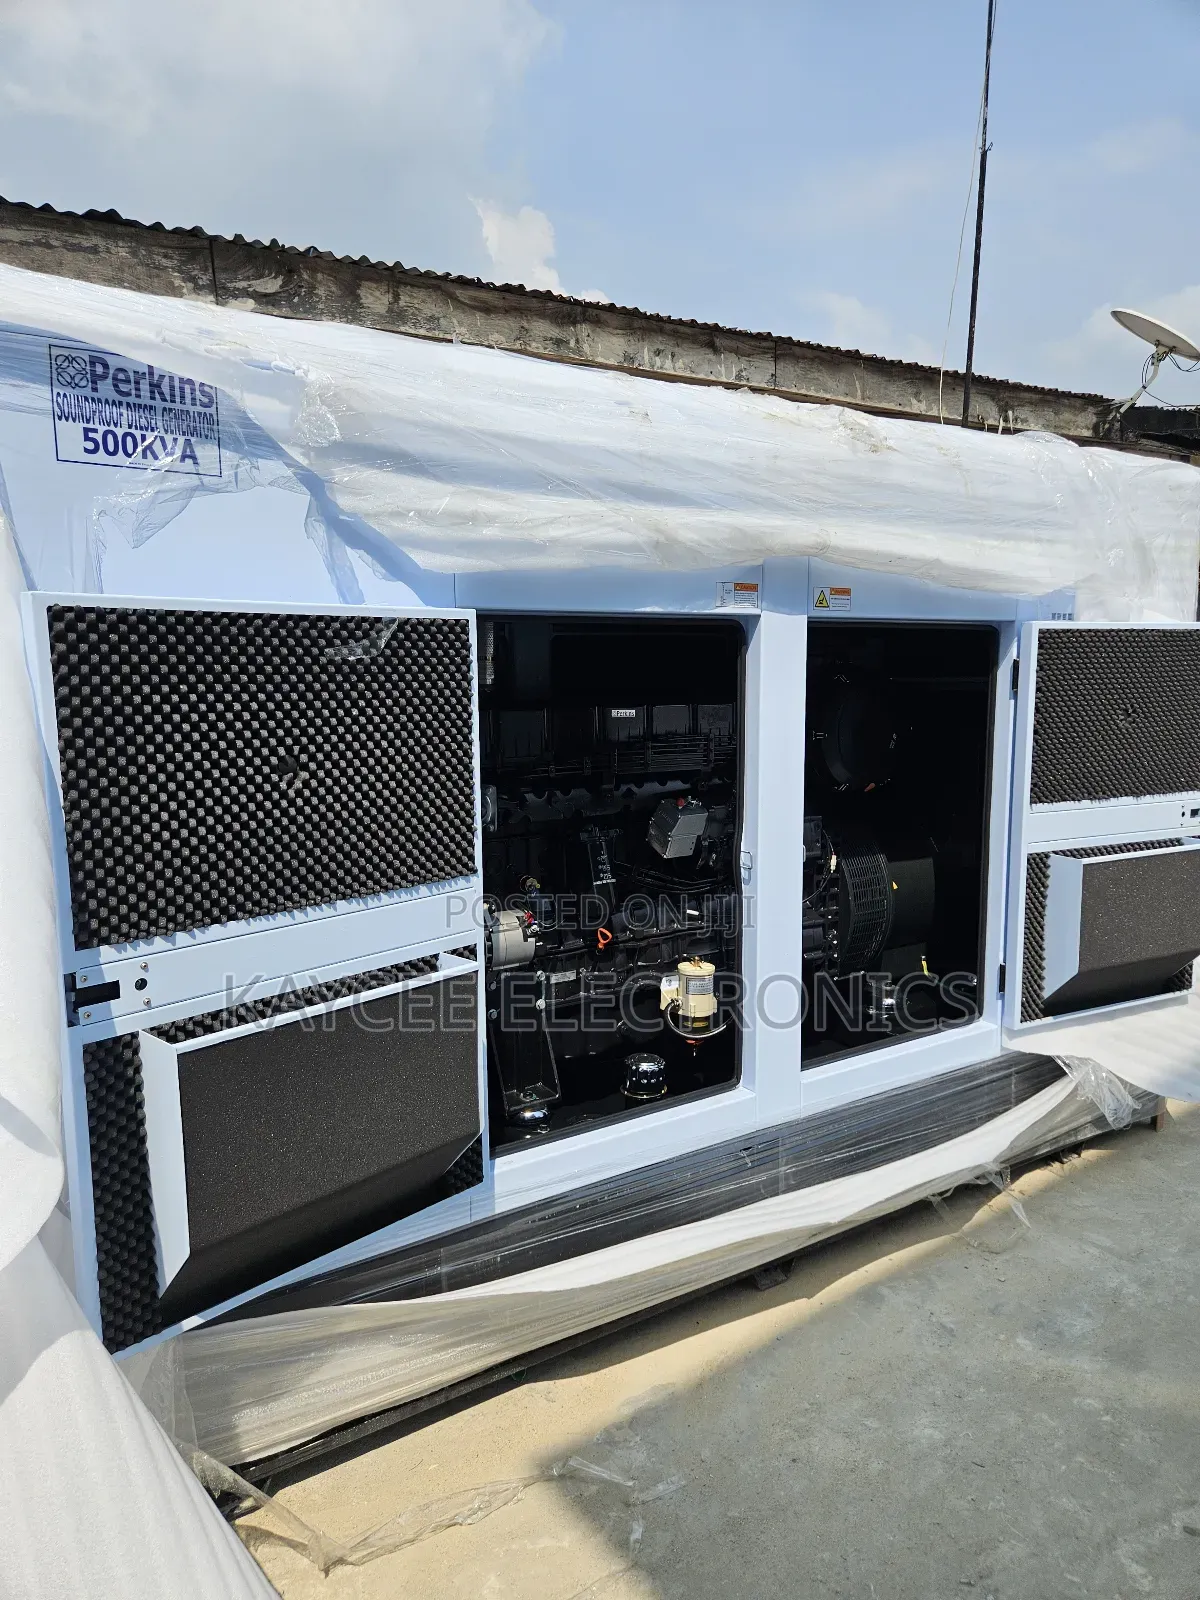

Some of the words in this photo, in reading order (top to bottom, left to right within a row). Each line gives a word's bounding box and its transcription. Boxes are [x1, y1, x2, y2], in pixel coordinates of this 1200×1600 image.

[88, 354, 215, 409] Perkins
[56, 391, 123, 427] SOUNDPROOF
[125, 401, 160, 433] DIESEL
[161, 406, 217, 441] GENERATOR
[83, 426, 199, 465] 500KVA
